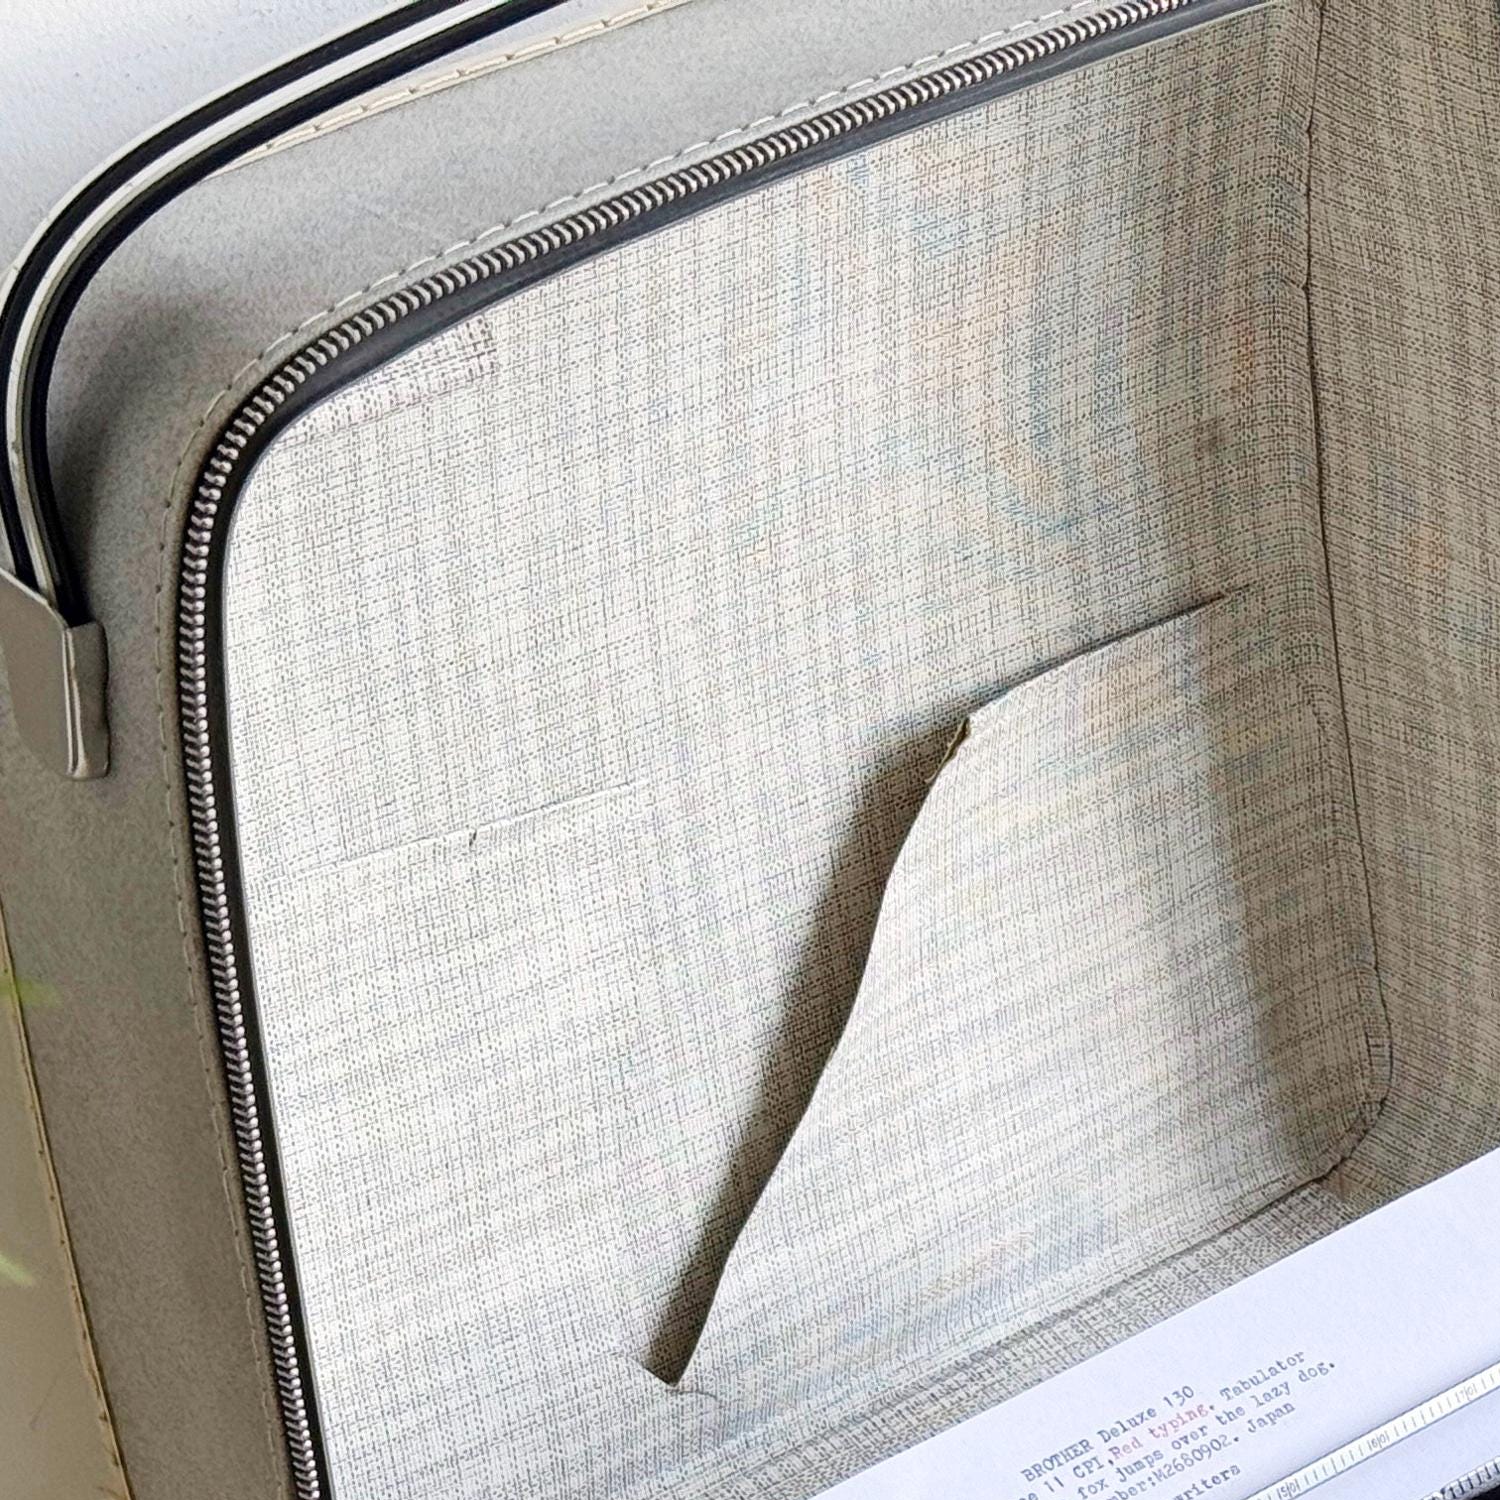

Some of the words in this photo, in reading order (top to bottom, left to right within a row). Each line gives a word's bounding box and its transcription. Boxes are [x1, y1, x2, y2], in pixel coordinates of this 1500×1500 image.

[1077, 1478, 1109, 1500] fox
[1116, 1450, 1164, 1483] jumps
[1171, 1425, 1209, 1450] over
[1214, 1406, 1246, 1426] the
[1250, 1381, 1291, 1408] lazy
[1298, 1362, 1335, 1383] dog.
[1148, 1404, 1215, 1439] typing.
[1219, 1351, 1304, 1401] Tabulator
[1247, 1402, 1296, 1433] Japan
[1021, 1438, 1094, 1482] BROTHER
[1097, 1407, 1157, 1443] Deluxe
